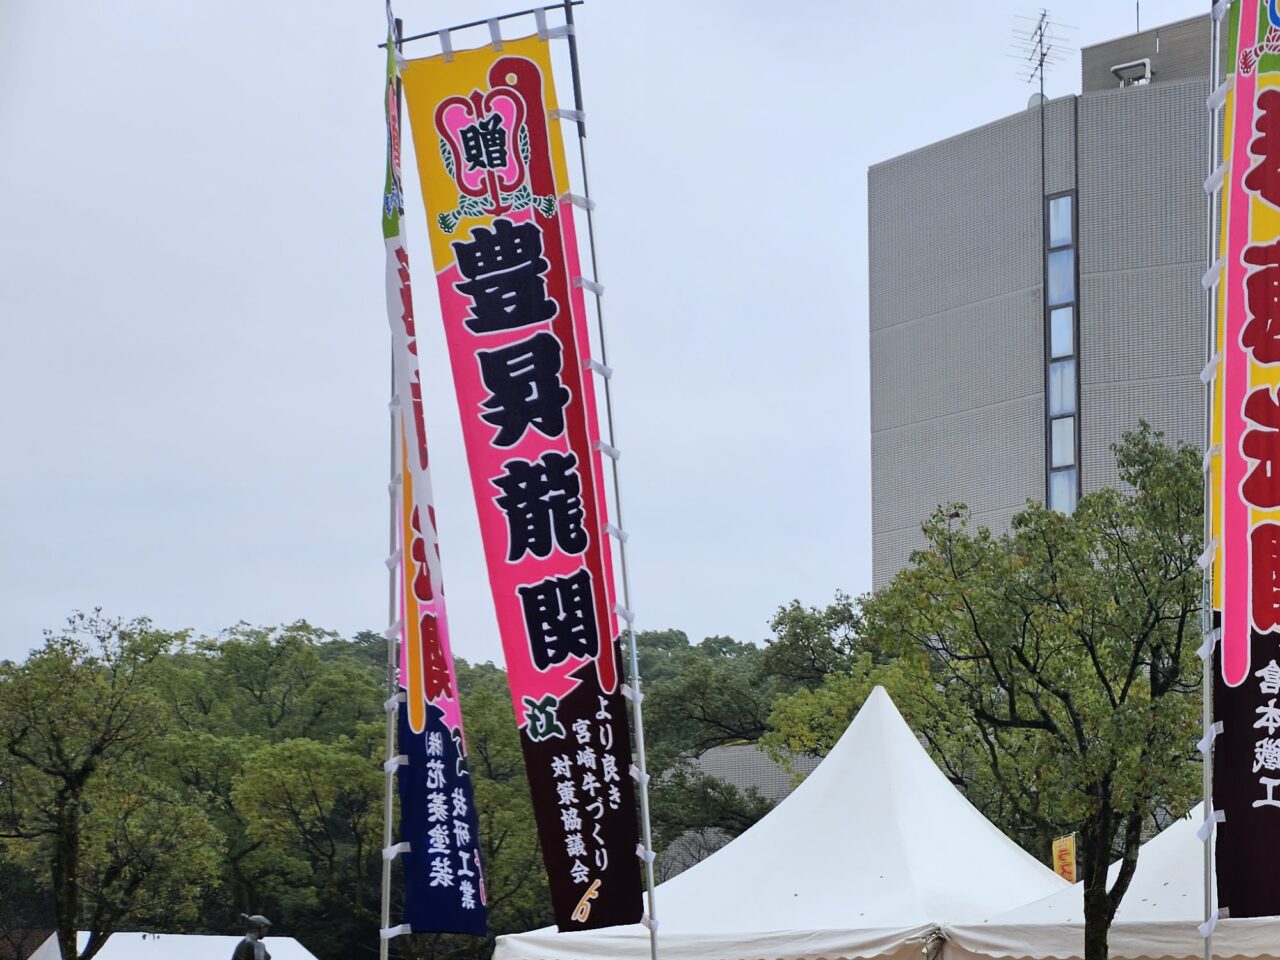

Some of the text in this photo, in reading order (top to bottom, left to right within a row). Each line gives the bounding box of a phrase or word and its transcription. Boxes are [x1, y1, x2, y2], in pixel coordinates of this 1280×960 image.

[459, 113, 507, 171] 贈
[572, 718, 608, 871] 宮崎牛づくり
[595, 695, 621, 809] より良き
[551, 754, 590, 884] 対策協議会
